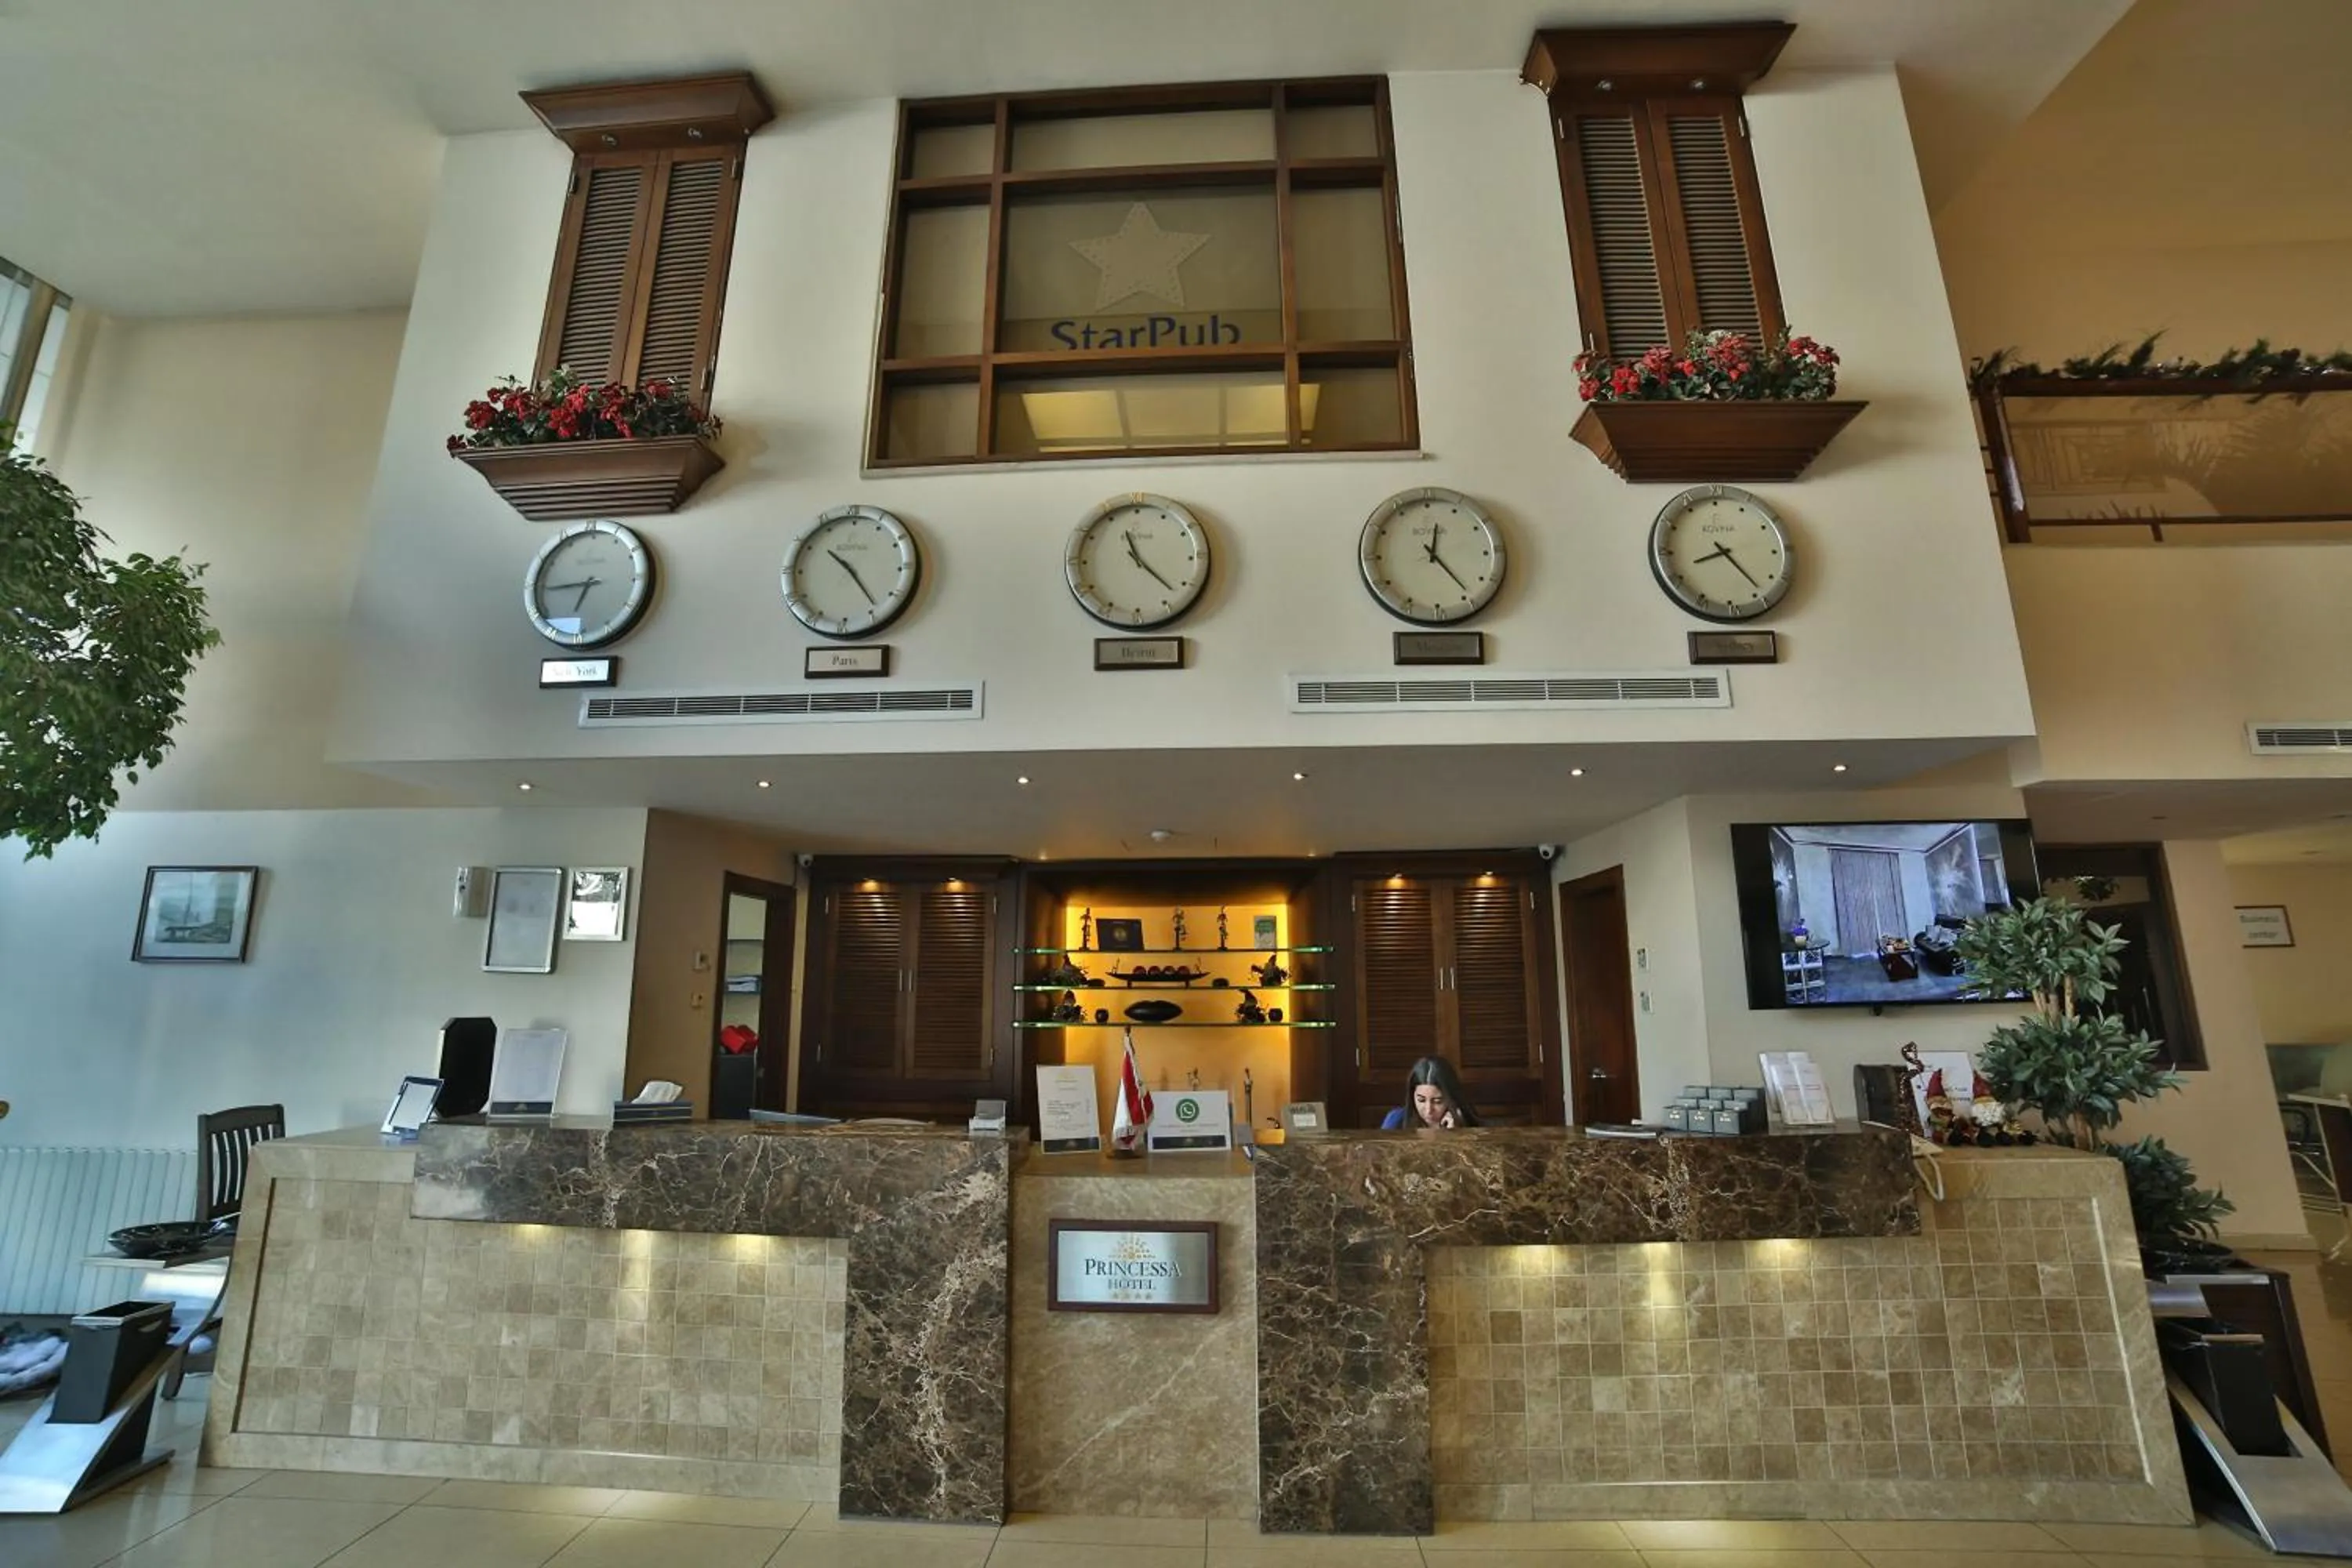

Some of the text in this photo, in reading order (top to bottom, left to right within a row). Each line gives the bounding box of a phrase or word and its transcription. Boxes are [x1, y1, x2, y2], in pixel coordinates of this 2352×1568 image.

[1051, 315, 1241, 350] StarPub
[832, 654, 858, 666] Paris
[577, 665, 598, 676] York
[1085, 1258, 1181, 1277] PRINCESSA
[1108, 1279, 1156, 1290] HOTEL
